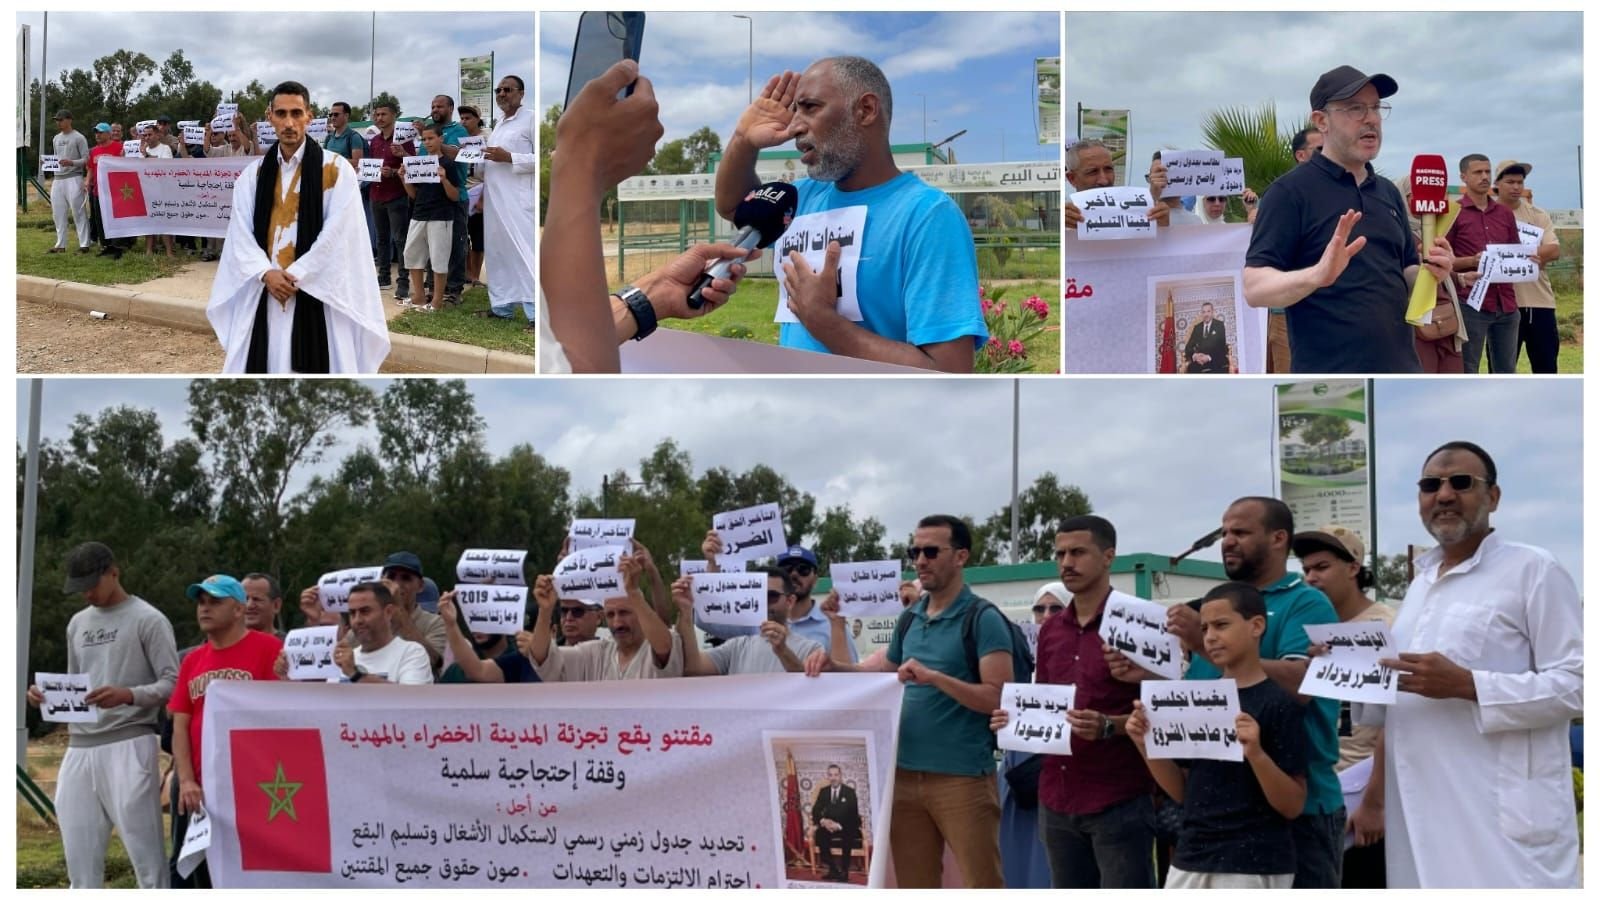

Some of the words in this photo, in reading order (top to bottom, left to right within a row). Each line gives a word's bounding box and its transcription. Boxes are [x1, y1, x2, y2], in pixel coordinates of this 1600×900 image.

[1000, 168, 1032, 185] البيع
[1415, 176, 1445, 187] PRESS
[1083, 192, 1116, 211] تأخير
[1415, 199, 1446, 213] MA.P
[1086, 215, 1125, 234] التسليم
[1126, 215, 1151, 232] بغينا
[725, 528, 774, 555] الضرر
[559, 555, 587, 576] تأخير
[460, 590, 489, 604] 2019
[493, 591, 521, 603] منذ
[561, 576, 596, 596] التسليم
[703, 600, 731, 615] ورسمي
[734, 597, 759, 613] واضح
[1108, 625, 1138, 654] حلولا
[1352, 630, 1387, 652] الوقت
[1142, 641, 1171, 666] نريد
[1315, 661, 1352, 688] يزداد
[1350, 662, 1393, 691] والضرر
[1044, 697, 1068, 714] نريد
[1151, 690, 1190, 712] نجلسو
[1194, 688, 1229, 711] بغينا
[339, 723, 407, 749] بالمهدية
[413, 724, 481, 749] الخضراء
[489, 723, 548, 750] المدينة
[557, 723, 609, 750] تجزئة
[617, 725, 651, 755] بقع
[660, 726, 713, 752] مقتنو
[1054, 722, 1065, 739] لا
[1151, 723, 1187, 746] المشروع
[1187, 723, 1221, 746] صاحب
[1222, 727, 1238, 748] مع
[441, 757, 490, 787] سلمية
[498, 758, 578, 790] إحتجاجية
[585, 760, 626, 790] وقفة
[506, 793, 532, 816] أجل
[538, 801, 557, 817] من
[352, 822, 385, 848] البقع
[391, 822, 438, 849] وتسليم
[443, 818, 492, 843] الأشغال
[497, 824, 557, 845] لاستكمال
[650, 829, 692, 855] جدول
[563, 833, 604, 856] رسمي
[610, 831, 645, 858] زمني
[699, 835, 745, 857] تحديد
[340, 857, 389, 880] المقتنين
[394, 860, 433, 883] جميع
[439, 858, 480, 881] حقوق
[487, 860, 520, 883] صون
[552, 861, 627, 886] والتعهدات
[707, 870, 751, 890] احترام
